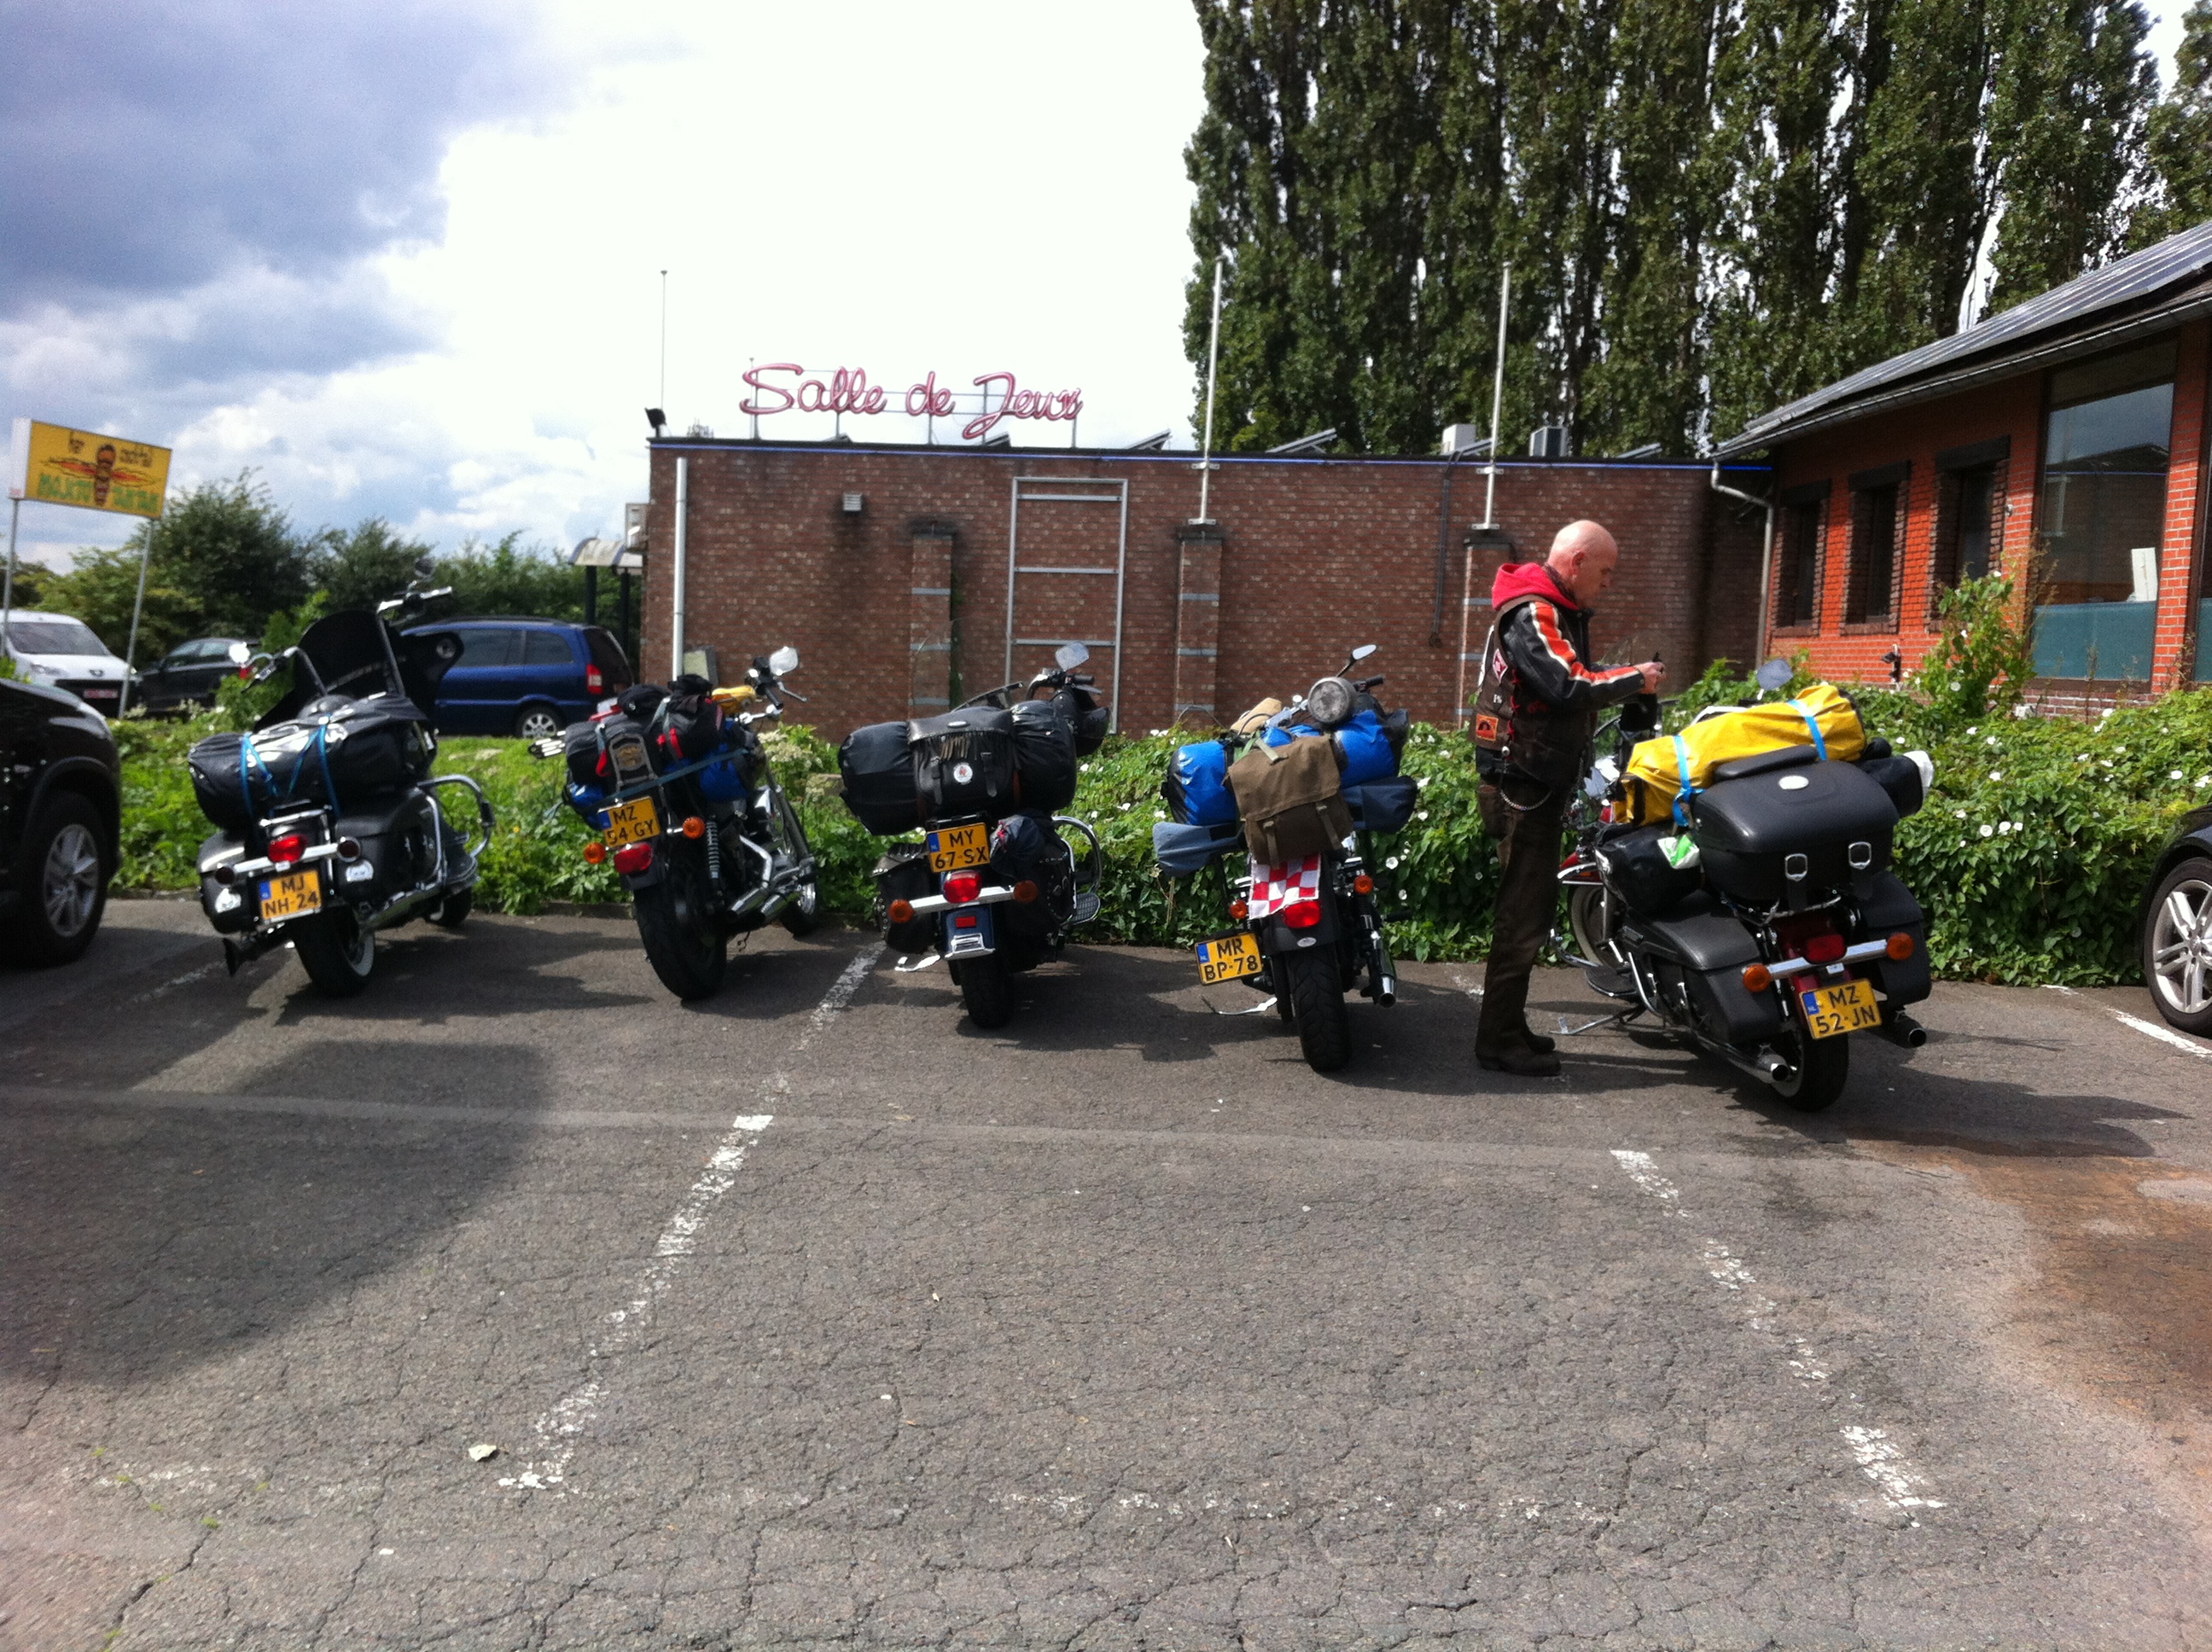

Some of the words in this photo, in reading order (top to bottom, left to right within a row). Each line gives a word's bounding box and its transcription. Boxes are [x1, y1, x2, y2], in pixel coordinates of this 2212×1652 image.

[739, 363, 888, 415] Salle
[905, 371, 957, 416] de
[963, 371, 1083, 439] Jeux
[612, 806, 637, 824] MZ
[949, 829, 975, 848] MY
[281, 875, 306, 895] MJ
[1216, 938, 1244, 959] MR
[1828, 986, 1860, 1009] MZ
